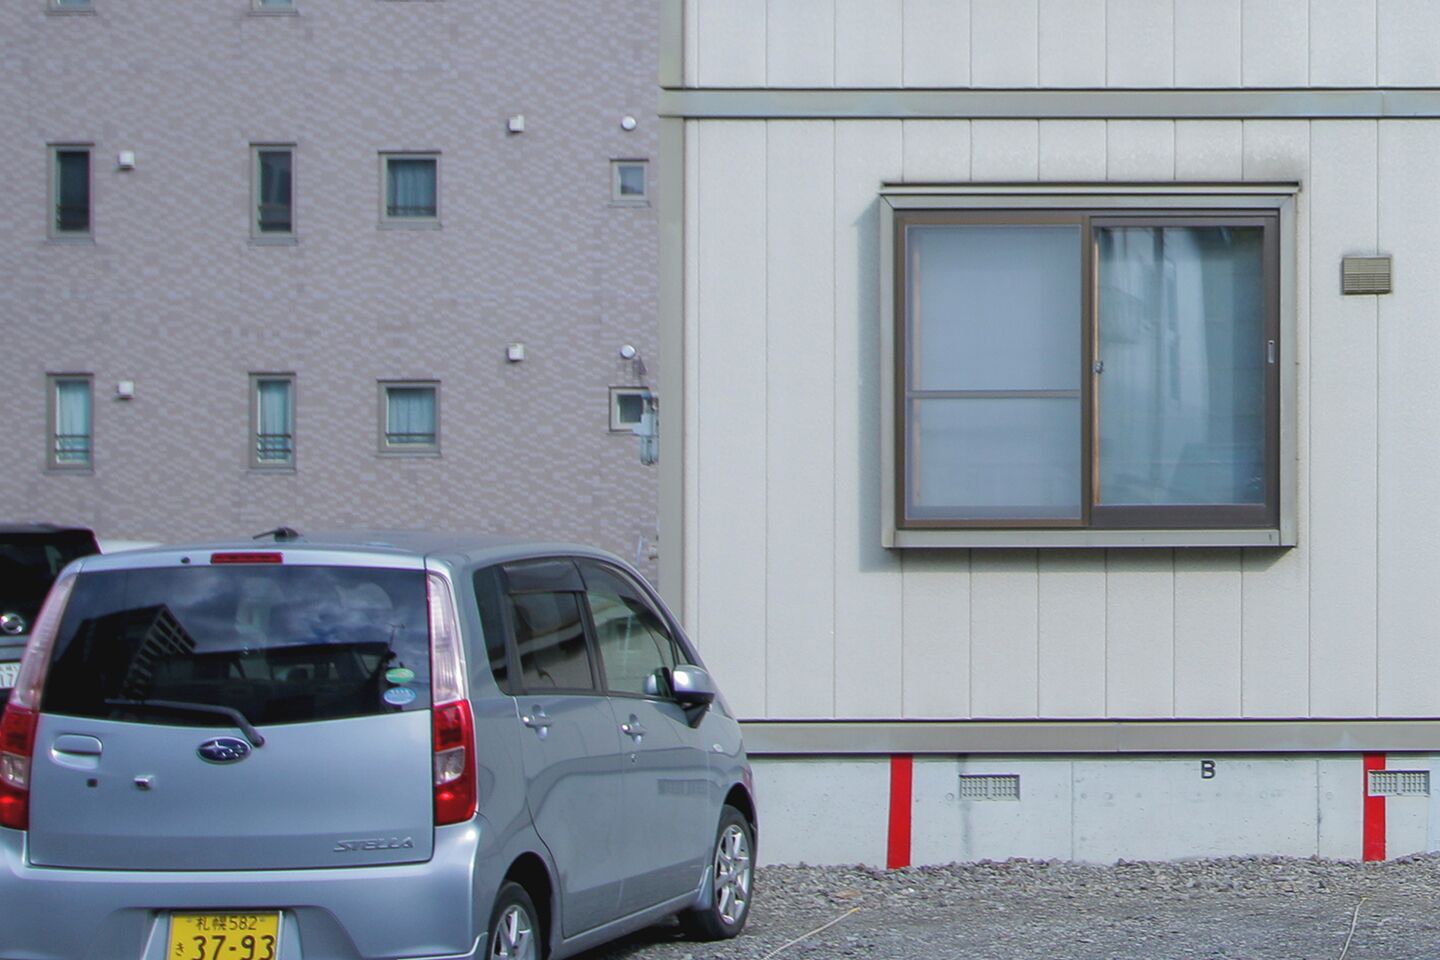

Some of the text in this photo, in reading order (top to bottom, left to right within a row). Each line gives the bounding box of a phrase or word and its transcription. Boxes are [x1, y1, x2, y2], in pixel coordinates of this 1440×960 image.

[1200, 759, 1216, 779] B
[332, 836, 415, 852] STELLA
[191, 934, 275, 960] 37-93
